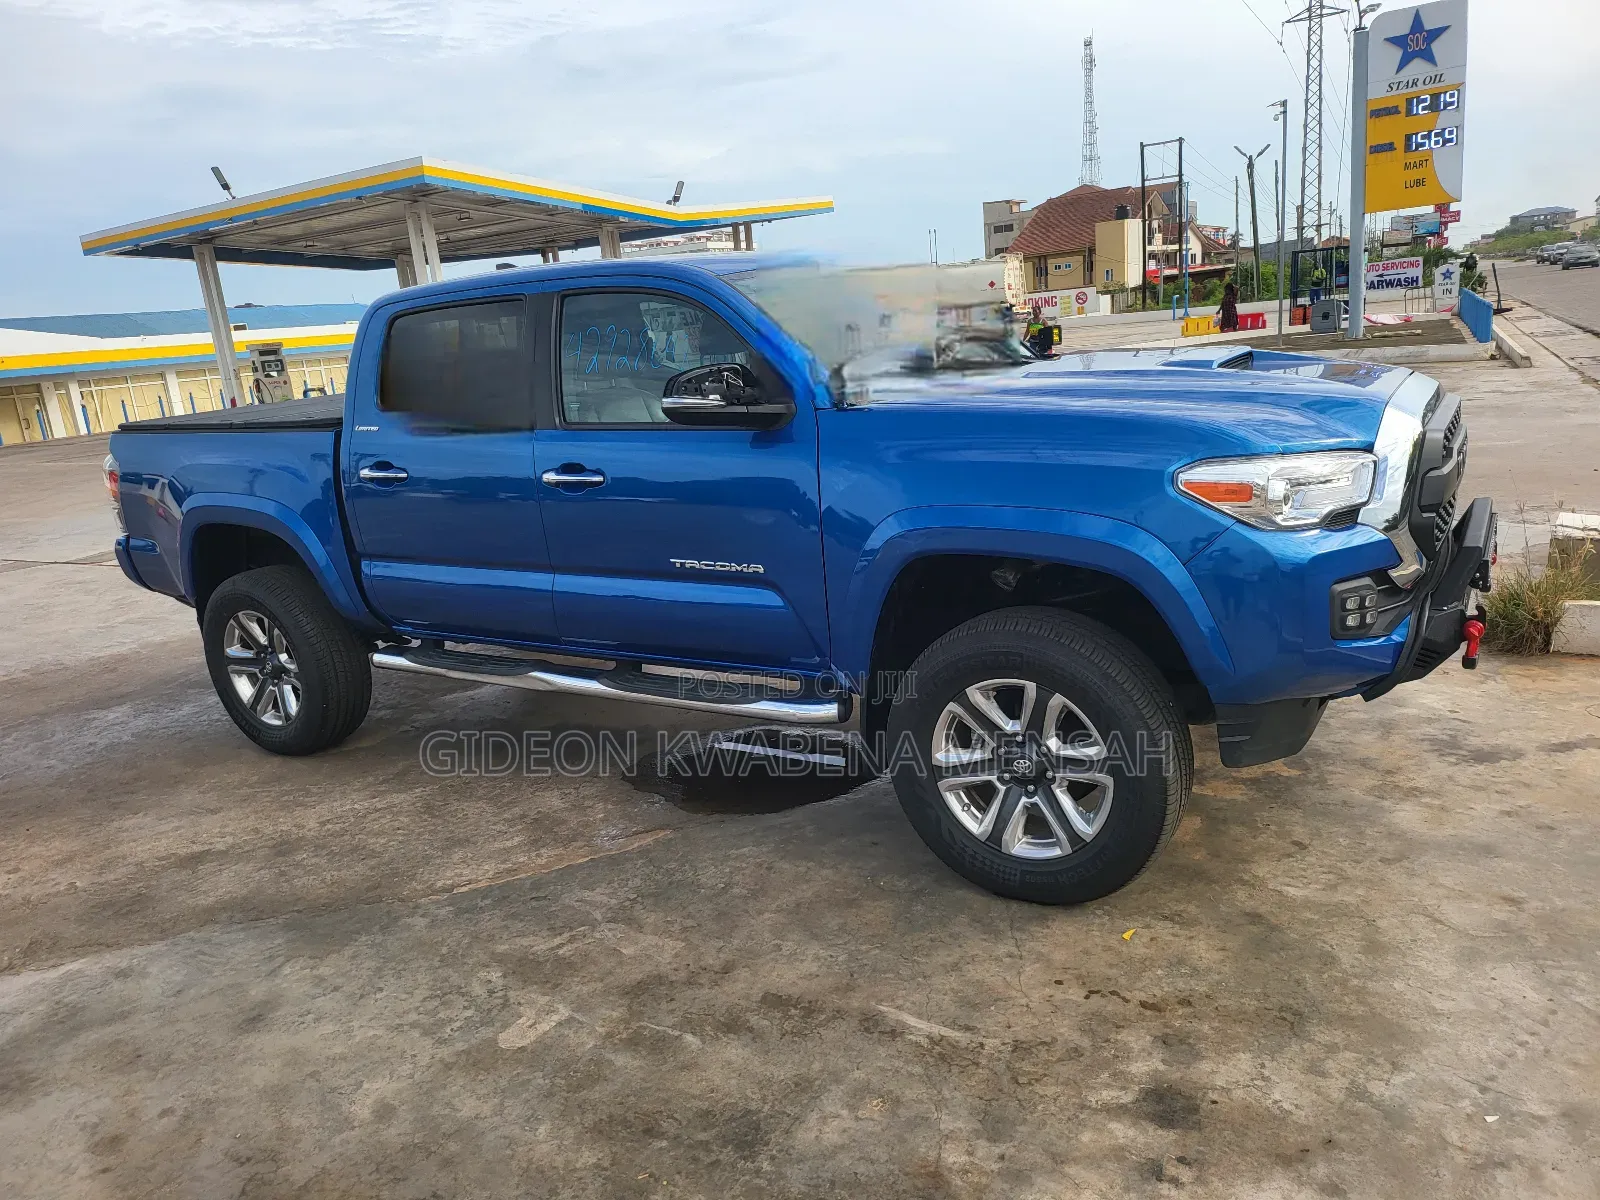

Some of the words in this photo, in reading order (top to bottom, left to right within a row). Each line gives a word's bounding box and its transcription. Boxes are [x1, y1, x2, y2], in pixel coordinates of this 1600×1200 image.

[1407, 32, 1427, 52] SOC
[1386, 77, 1419, 93] STAR
[1422, 72, 1445, 87] OIL
[1403, 158, 1429, 171] MART
[1404, 177, 1426, 189] LUBE
[1366, 263, 1380, 273] UTO
[1381, 259, 1420, 272] SERVICING
[669, 558, 765, 574] TACOMA
